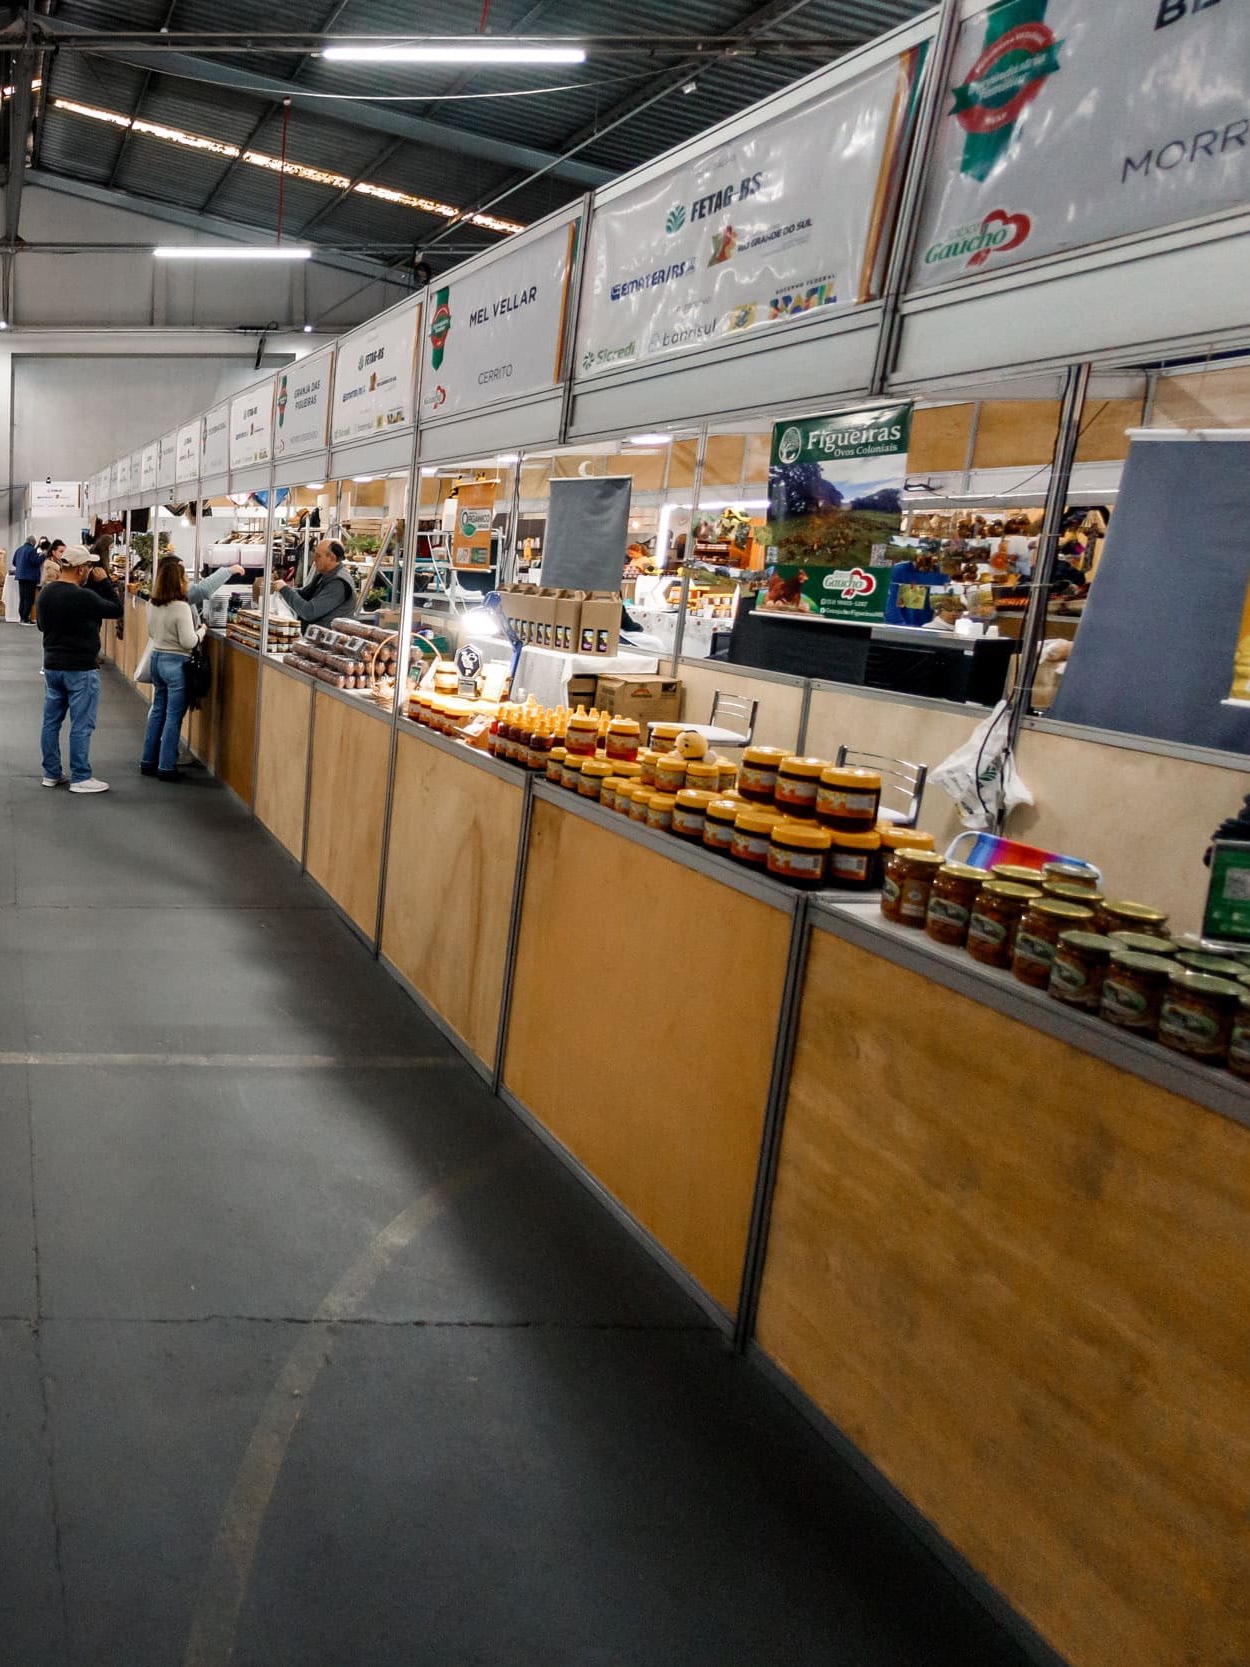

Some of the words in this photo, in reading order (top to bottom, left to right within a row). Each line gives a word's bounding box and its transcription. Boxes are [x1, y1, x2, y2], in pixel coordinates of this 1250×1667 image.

[690, 172, 763, 223] FETAG-RS
[782, 223, 796, 236] DO
[796, 218, 813, 232] SUL
[469, 307, 490, 328] MEL
[493, 286, 538, 318] VELLAR
[477, 363, 513, 385] CERRITO
[806, 424, 902, 453] Figueiras
[834, 447, 856, 458] Ovos
[856, 443, 899, 456] Coloniais
